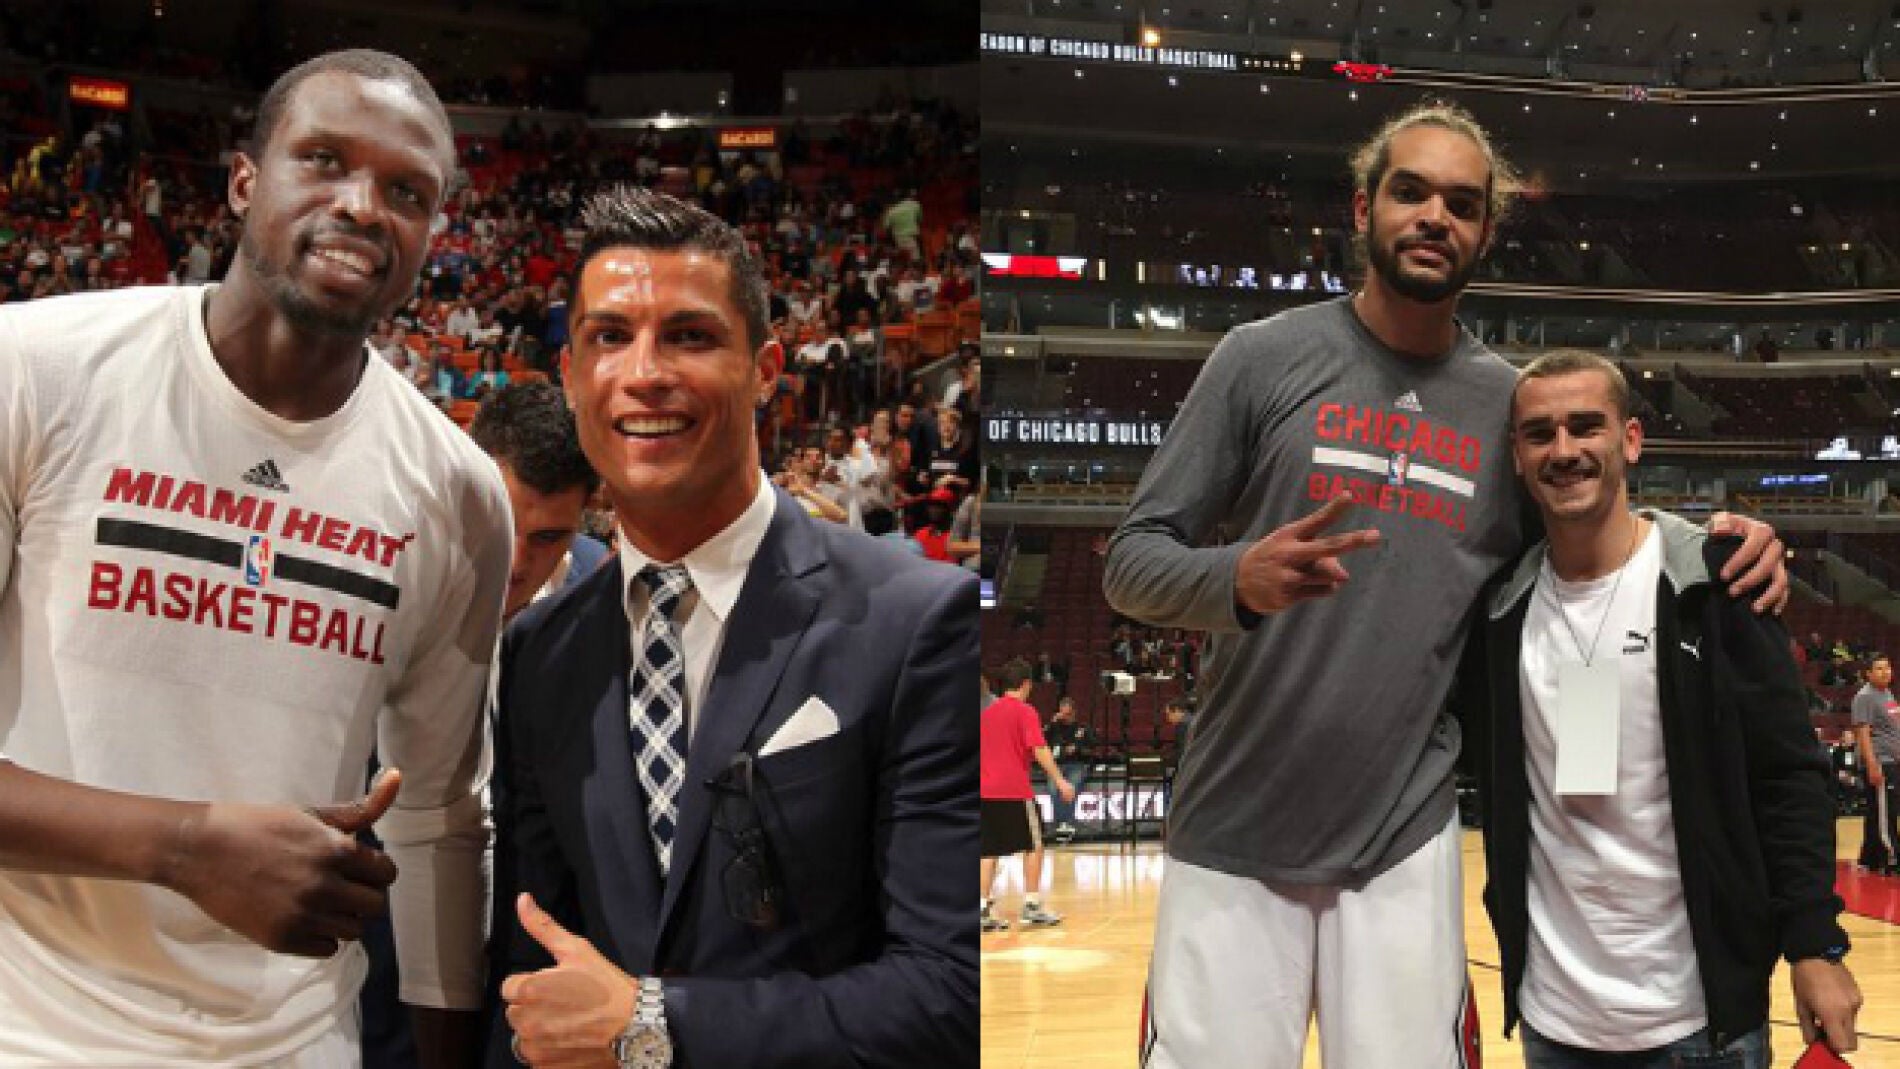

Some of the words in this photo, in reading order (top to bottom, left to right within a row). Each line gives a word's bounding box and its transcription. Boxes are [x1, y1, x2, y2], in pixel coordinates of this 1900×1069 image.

[1049, 38, 1110, 59] CHICAGO
[1113, 44, 1155, 62] BULLS
[1157, 48, 1237, 70] BASKETBALL
[988, 418, 1011, 440] OF
[1017, 419, 1100, 443] CHICAGO
[1106, 422, 1161, 446] BULLS
[1316, 401, 1482, 475] CHICAGO
[103, 467, 277, 534] MIAMI
[279, 508, 415, 568] HEAT
[1308, 472, 1468, 533] BASKETBALL
[87, 560, 386, 665] BASKETBALL
